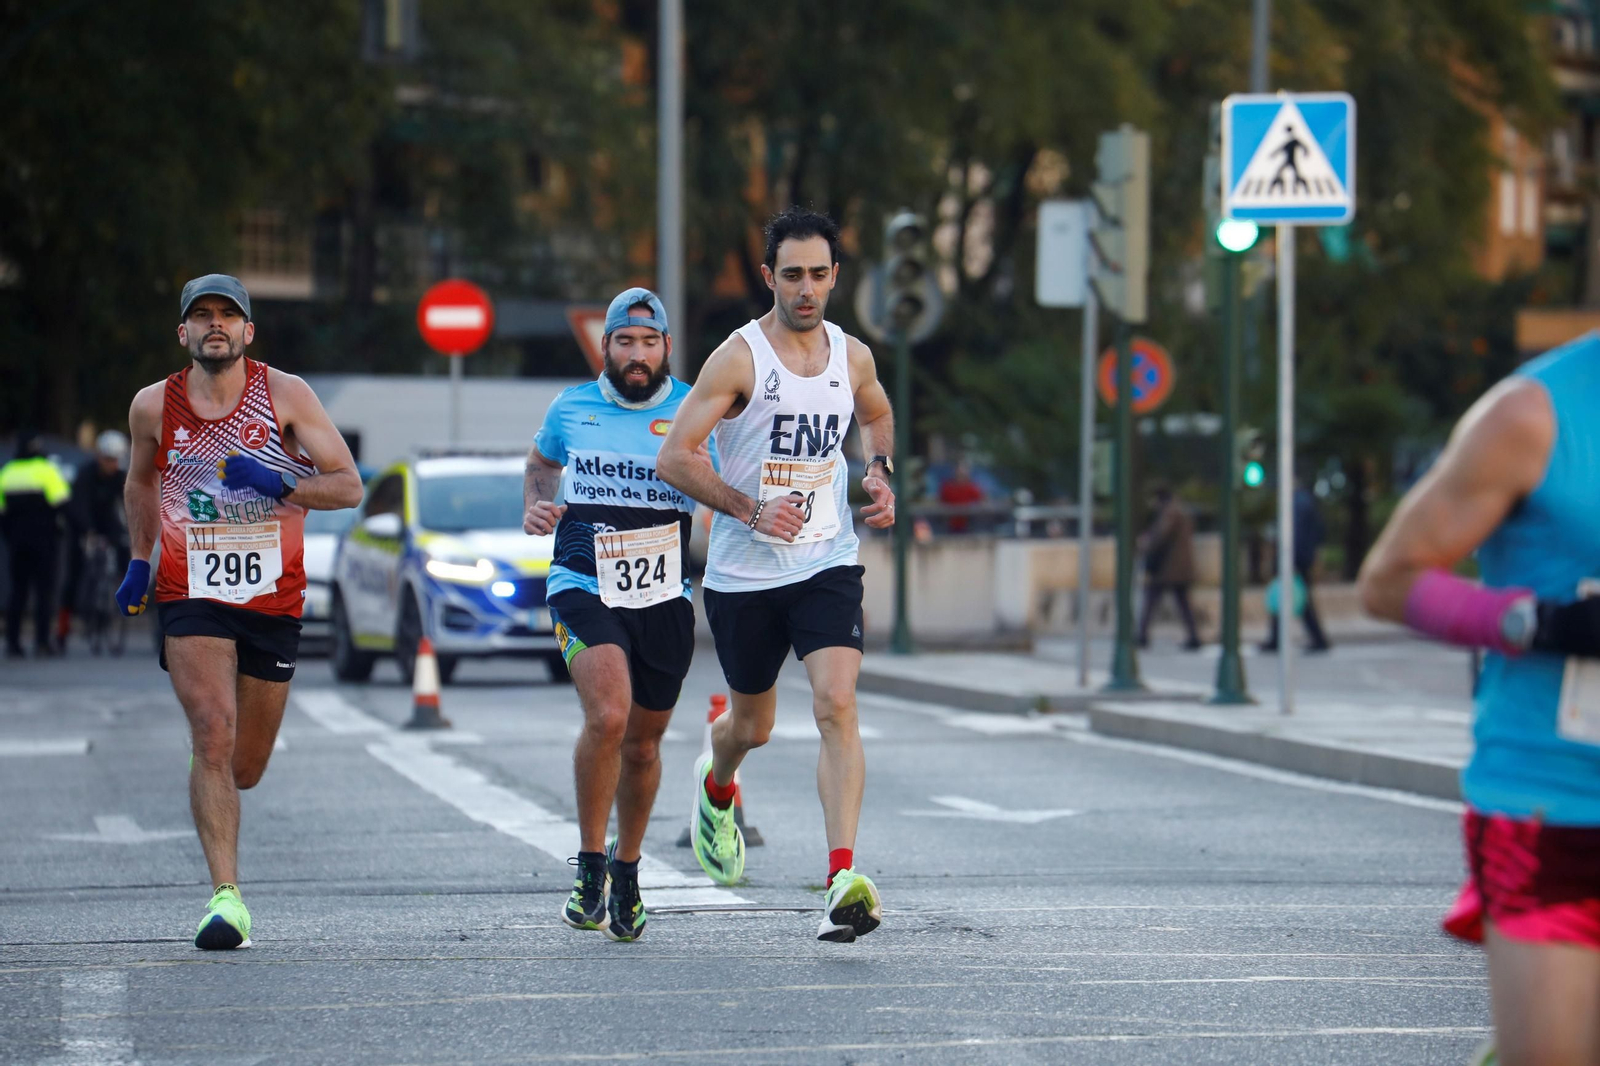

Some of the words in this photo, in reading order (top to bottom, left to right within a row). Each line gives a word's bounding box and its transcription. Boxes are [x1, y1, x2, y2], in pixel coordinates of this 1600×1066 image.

[769, 413, 840, 458] ENA
[764, 462, 792, 487] XLI
[573, 481, 617, 499] Virgen
[621, 486, 642, 499] de
[647, 488, 684, 505] Belén
[190, 527, 216, 550] XLI
[599, 535, 625, 559] XLI
[205, 552, 262, 587] 296
[615, 553, 666, 592] 324
